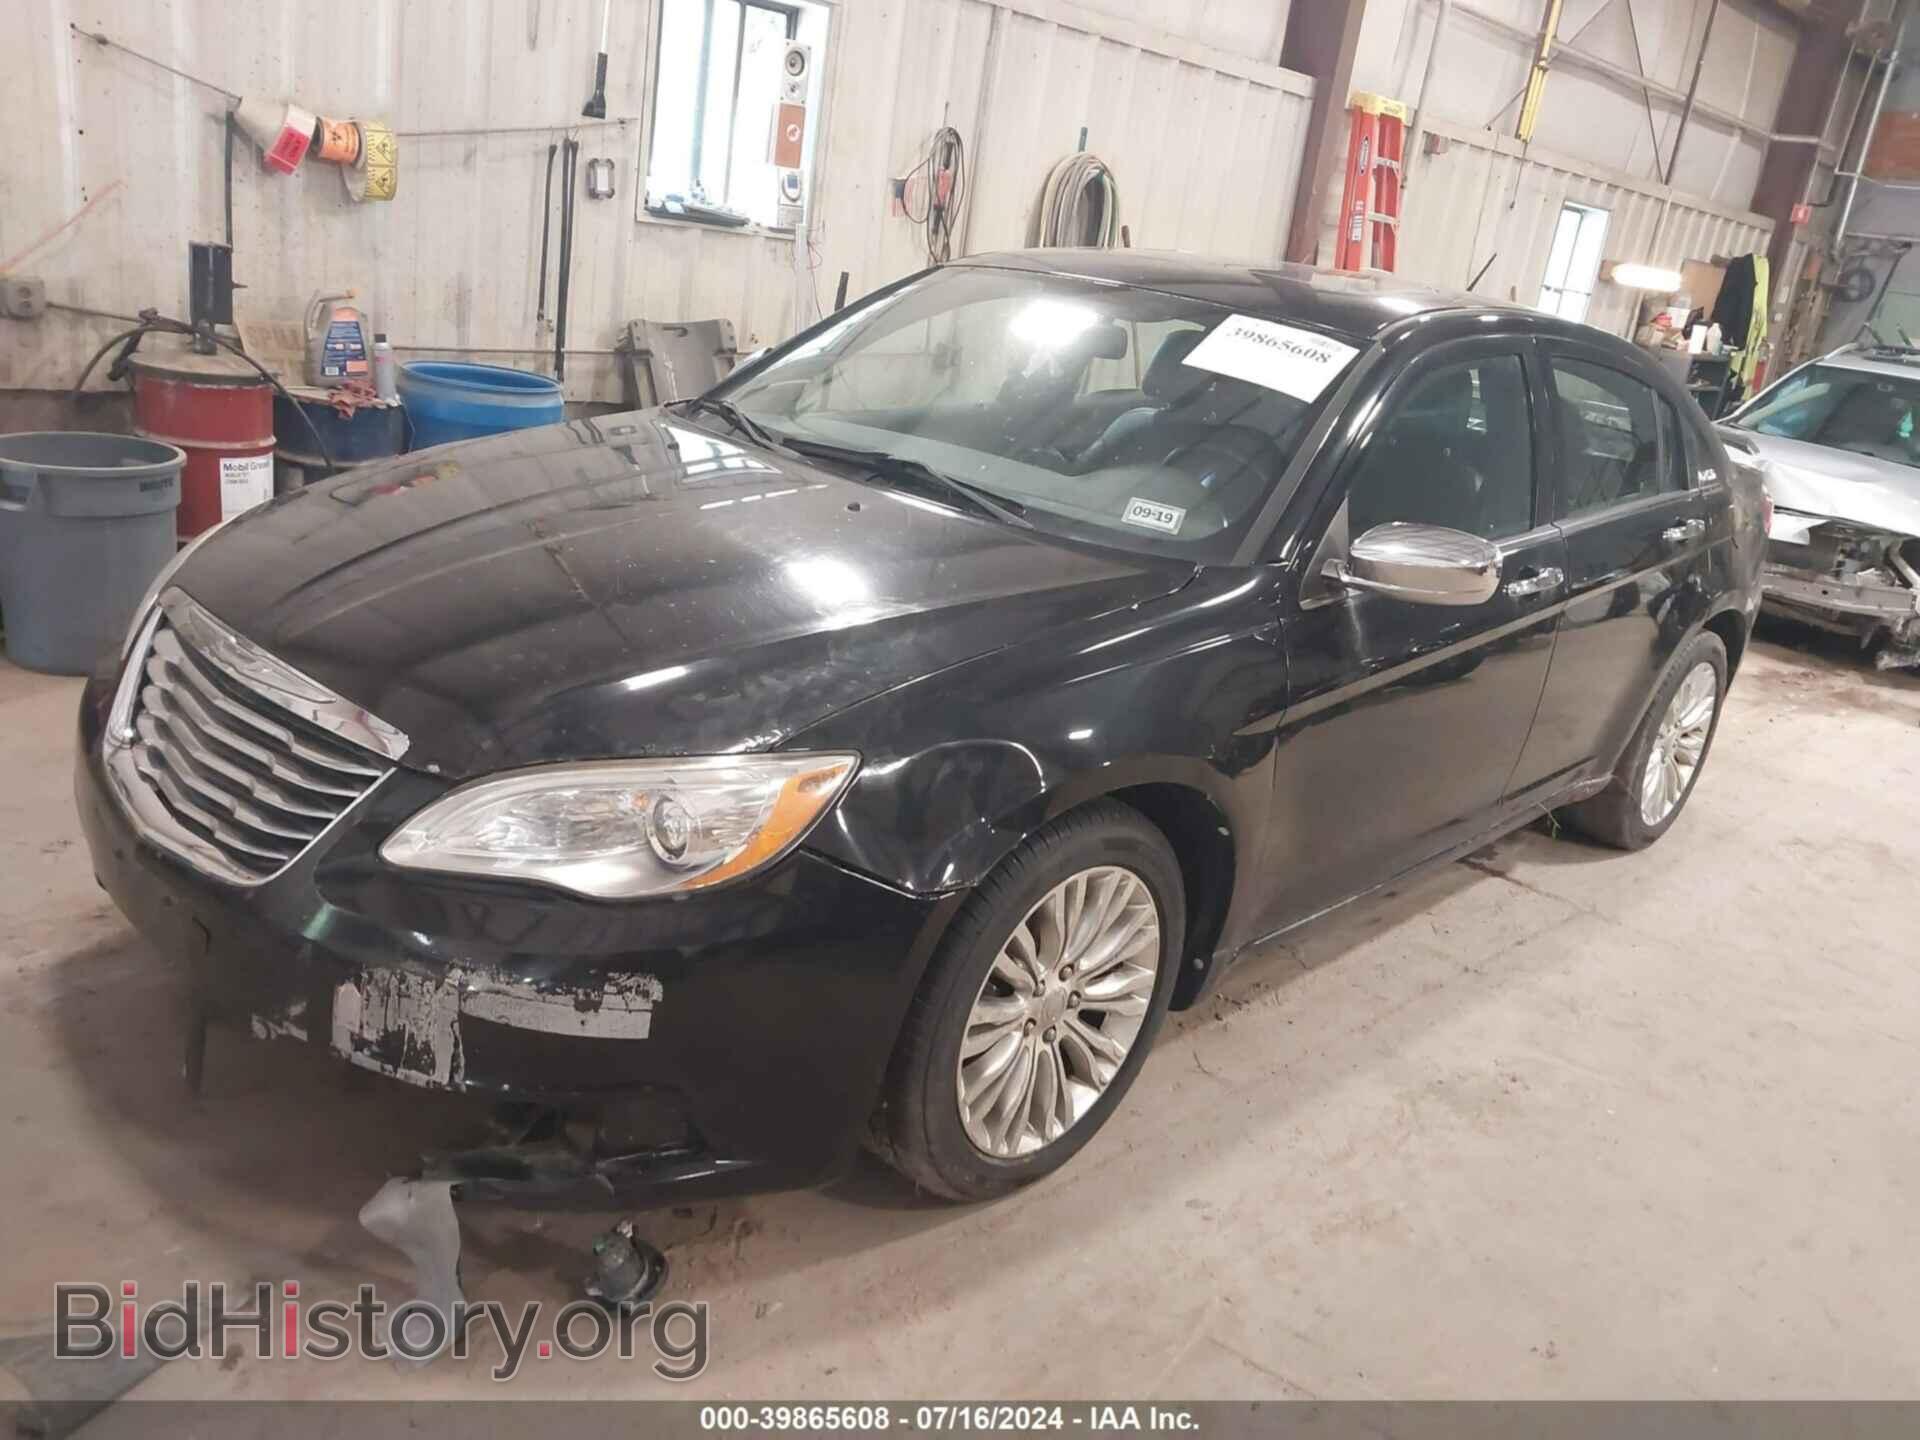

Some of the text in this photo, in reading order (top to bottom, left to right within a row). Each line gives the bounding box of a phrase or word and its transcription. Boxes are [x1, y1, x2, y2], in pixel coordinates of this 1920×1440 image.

[1227, 326, 1332, 364] 39865608
[223, 462, 249, 471] Mobil
[1132, 505, 1173, 523] 09-19
